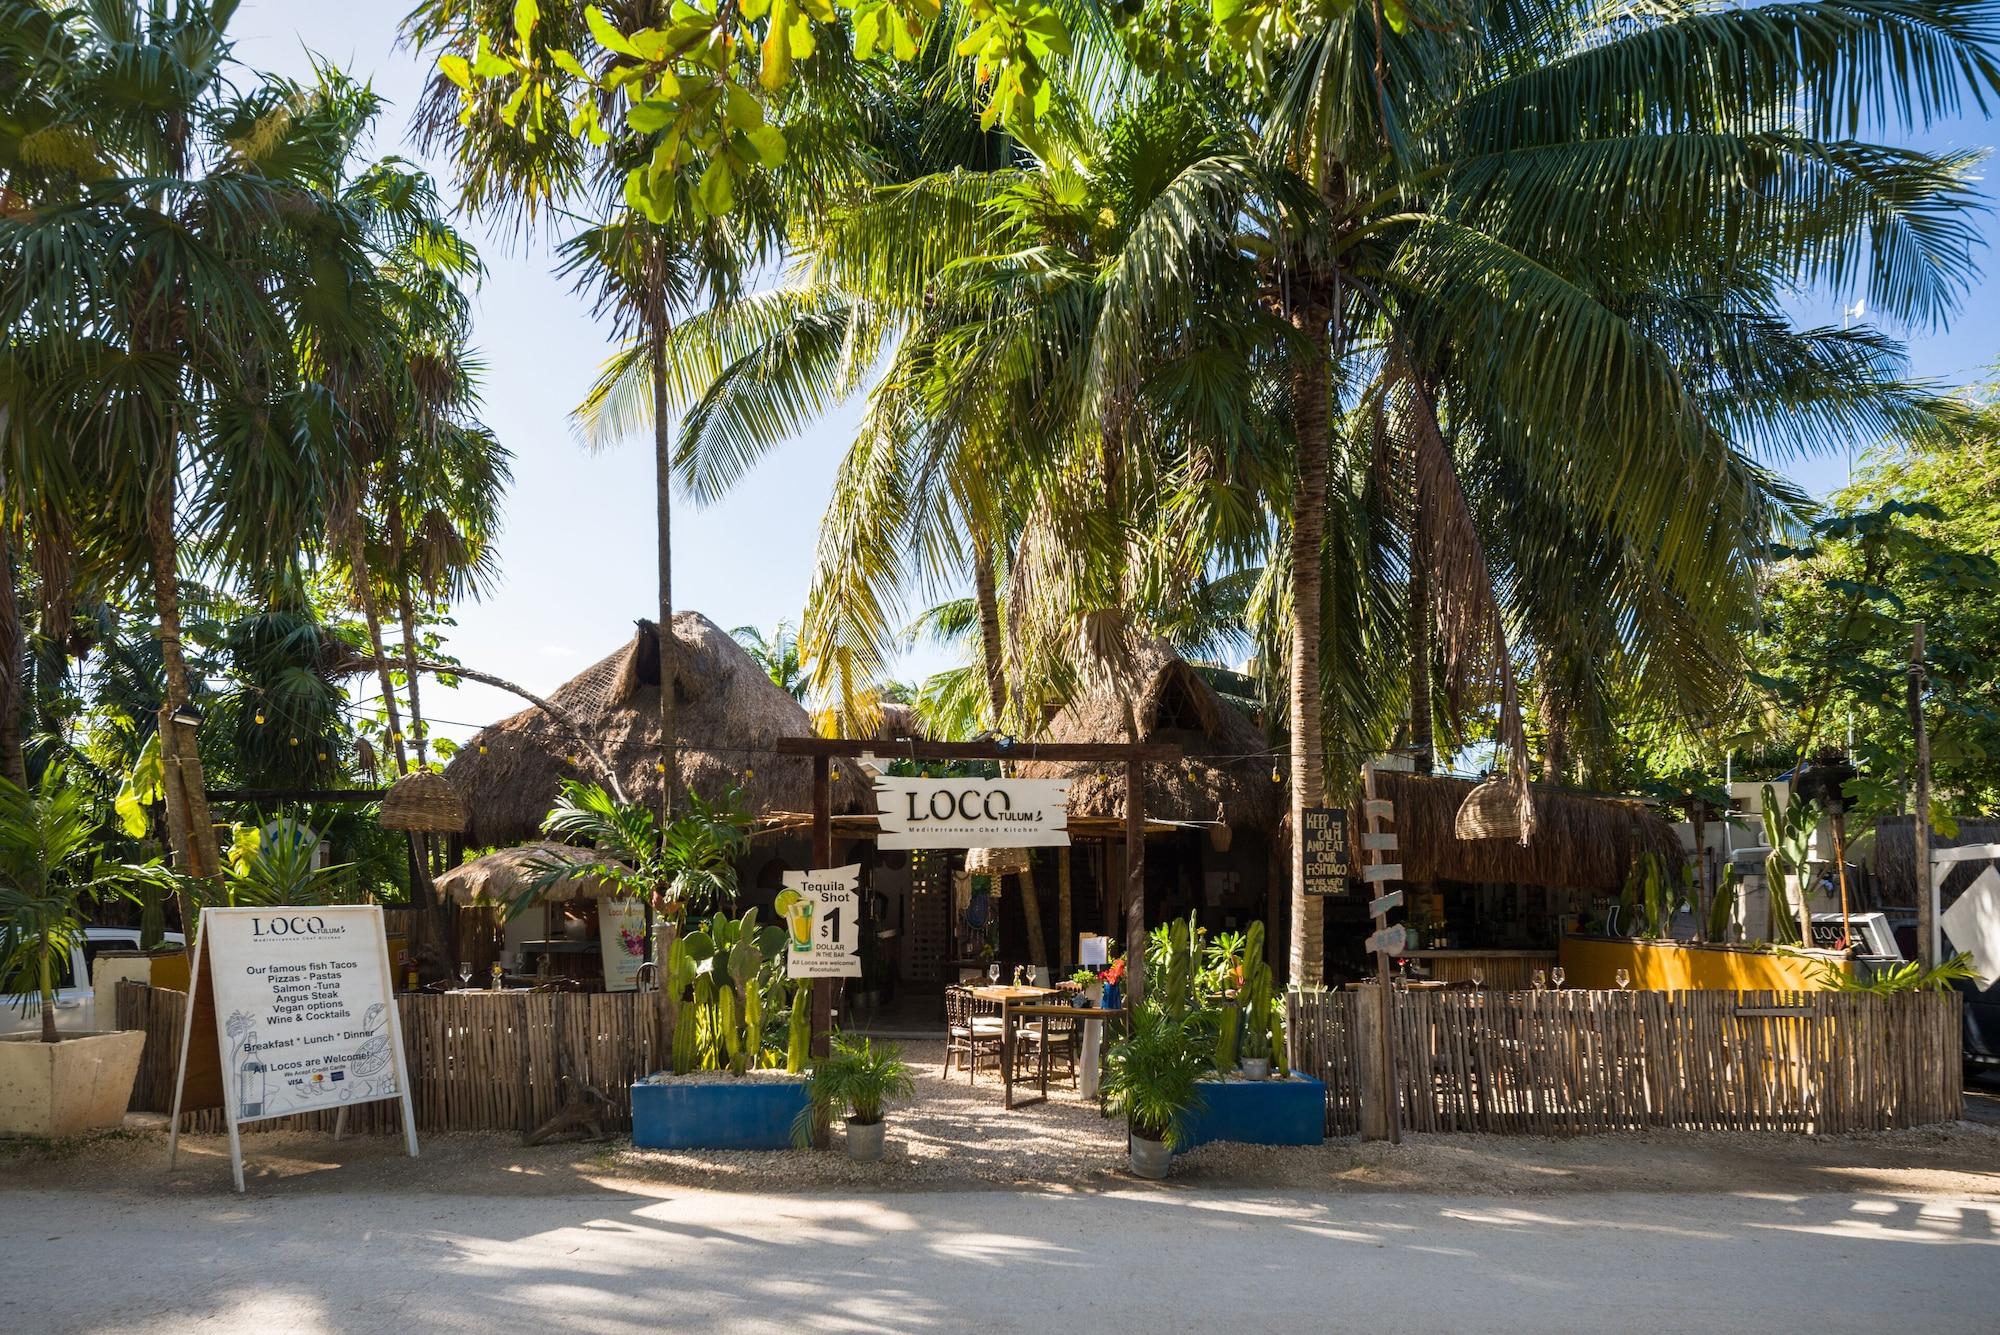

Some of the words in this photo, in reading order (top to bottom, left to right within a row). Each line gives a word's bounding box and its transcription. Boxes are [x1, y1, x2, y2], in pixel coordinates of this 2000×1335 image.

[905, 790, 1011, 821] LOCO
[998, 812, 1033, 821] TULUM
[1306, 813, 1329, 829] KEEP
[1317, 829, 1341, 841] CALM
[1306, 841, 1325, 852] AND
[1326, 841, 1344, 852] EAT
[1317, 852, 1336, 863] OUR
[800, 881, 845, 893] Tequila
[1327, 877, 1344, 886] VERY
[821, 892, 850, 902] Shot
[251, 916, 324, 936] LOCO
[246, 966, 267, 975] Our
[269, 964, 307, 973] famous
[309, 962, 328, 971] fish
[329, 961, 358, 969] Tacos
[267, 975, 300, 983] Pizzas
[309, 971, 342, 981] Pastas
[272, 984, 311, 993] Salmon
[275, 993, 309, 1004] Angus
[311, 990, 339, 1000] Steak
[272, 1004, 304, 1014] Vegan
[307, 1000, 344, 1011] options
[266, 1015, 292, 1025] Wine
[295, 1013, 303, 1021] &
[305, 1009, 351, 1021] Cocktails
[243, 1039, 294, 1052] Breakfast
[303, 1033, 334, 1045] Lunch
[343, 1030, 375, 1040] Dinner
[253, 1064, 268, 1075] All
[270, 1060, 302, 1072] Locos
[305, 1058, 321, 1067] are
[323, 1051, 370, 1064] Welcome!
[287, 1078, 304, 1086] VISA
